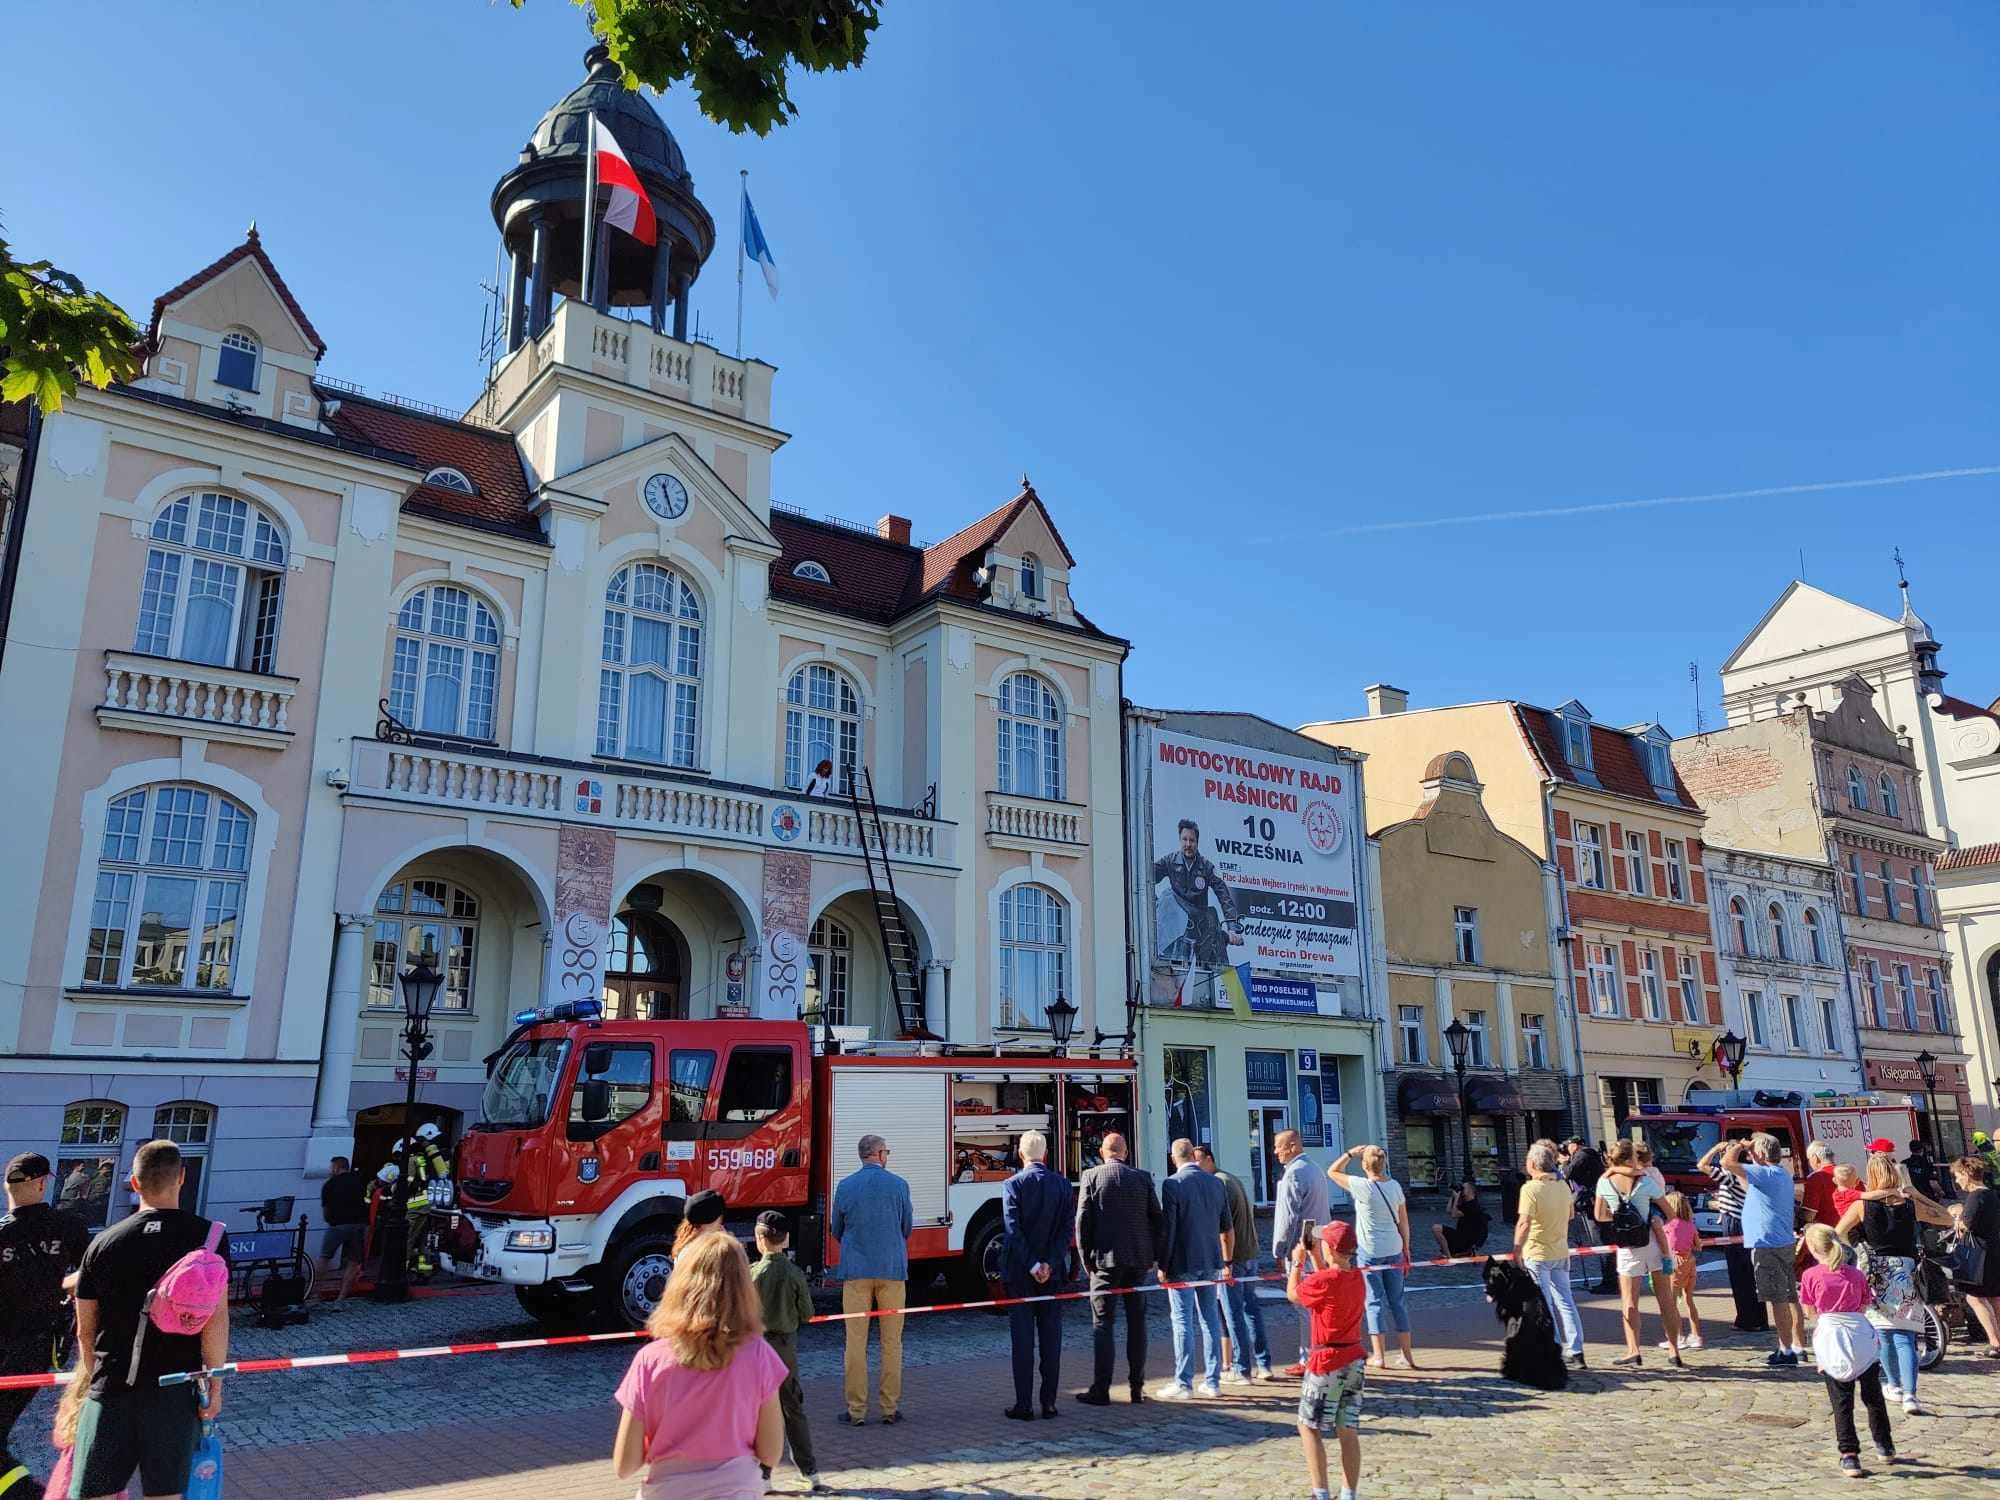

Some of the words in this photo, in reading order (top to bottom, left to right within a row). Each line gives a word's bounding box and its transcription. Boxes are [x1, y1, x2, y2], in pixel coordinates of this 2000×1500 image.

[1160, 743, 1295, 785] MOTOCYKLOWY
[1300, 770, 1342, 795] RAJD
[1204, 779, 1298, 813] PIAŚNICKI
[1243, 815, 1275, 841] 10
[1215, 838, 1304, 865] WRZEŚNIA
[1249, 905, 1274, 915] godz.
[1278, 900, 1326, 920] 12:00
[1237, 914, 1292, 944] Serdecznie
[1296, 928, 1353, 950] zapraszam!
[1258, 946, 1296, 960] Marcin
[1300, 950, 1335, 963] Drewa
[1269, 985, 1309, 996] POSELSKIE
[1304, 1056, 1312, 1069] 9
[1880, 1064, 1921, 1084] Księgarnia
